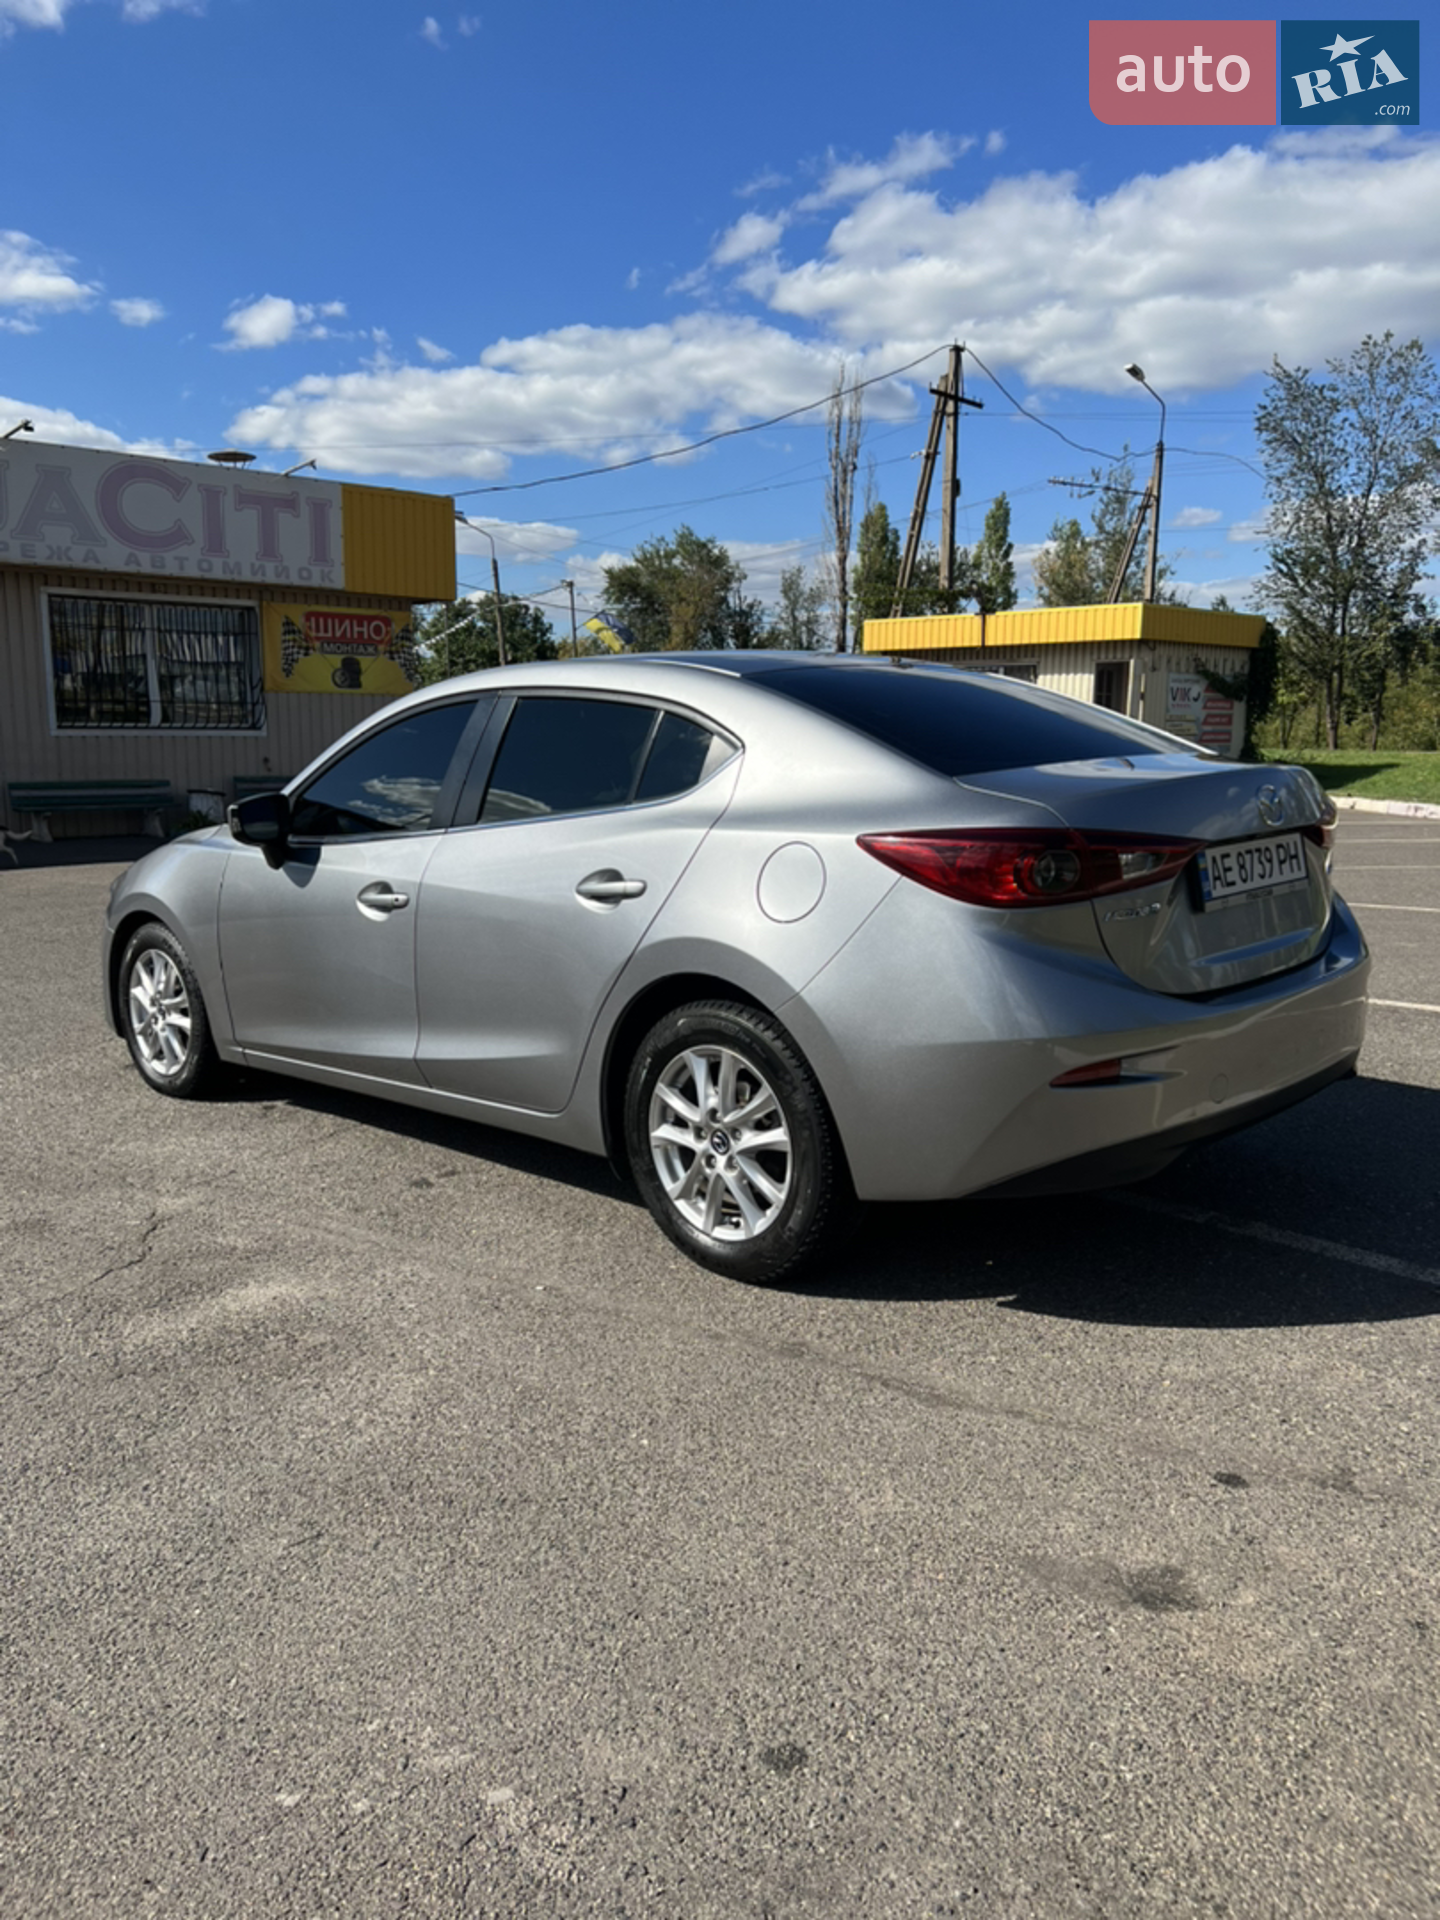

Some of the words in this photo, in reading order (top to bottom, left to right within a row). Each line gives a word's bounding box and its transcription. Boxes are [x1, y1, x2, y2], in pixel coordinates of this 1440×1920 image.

[0, 459, 335, 568] ACITI
[124, 552, 335, 585] АВТОМИЙОК
[309, 616, 387, 641] ШИНО
[322, 642, 376, 655] МОНТАЖ
[1211, 853, 1237, 890] AE
[1236, 845, 1274, 884] 8739
[1275, 840, 1302, 876] PH
